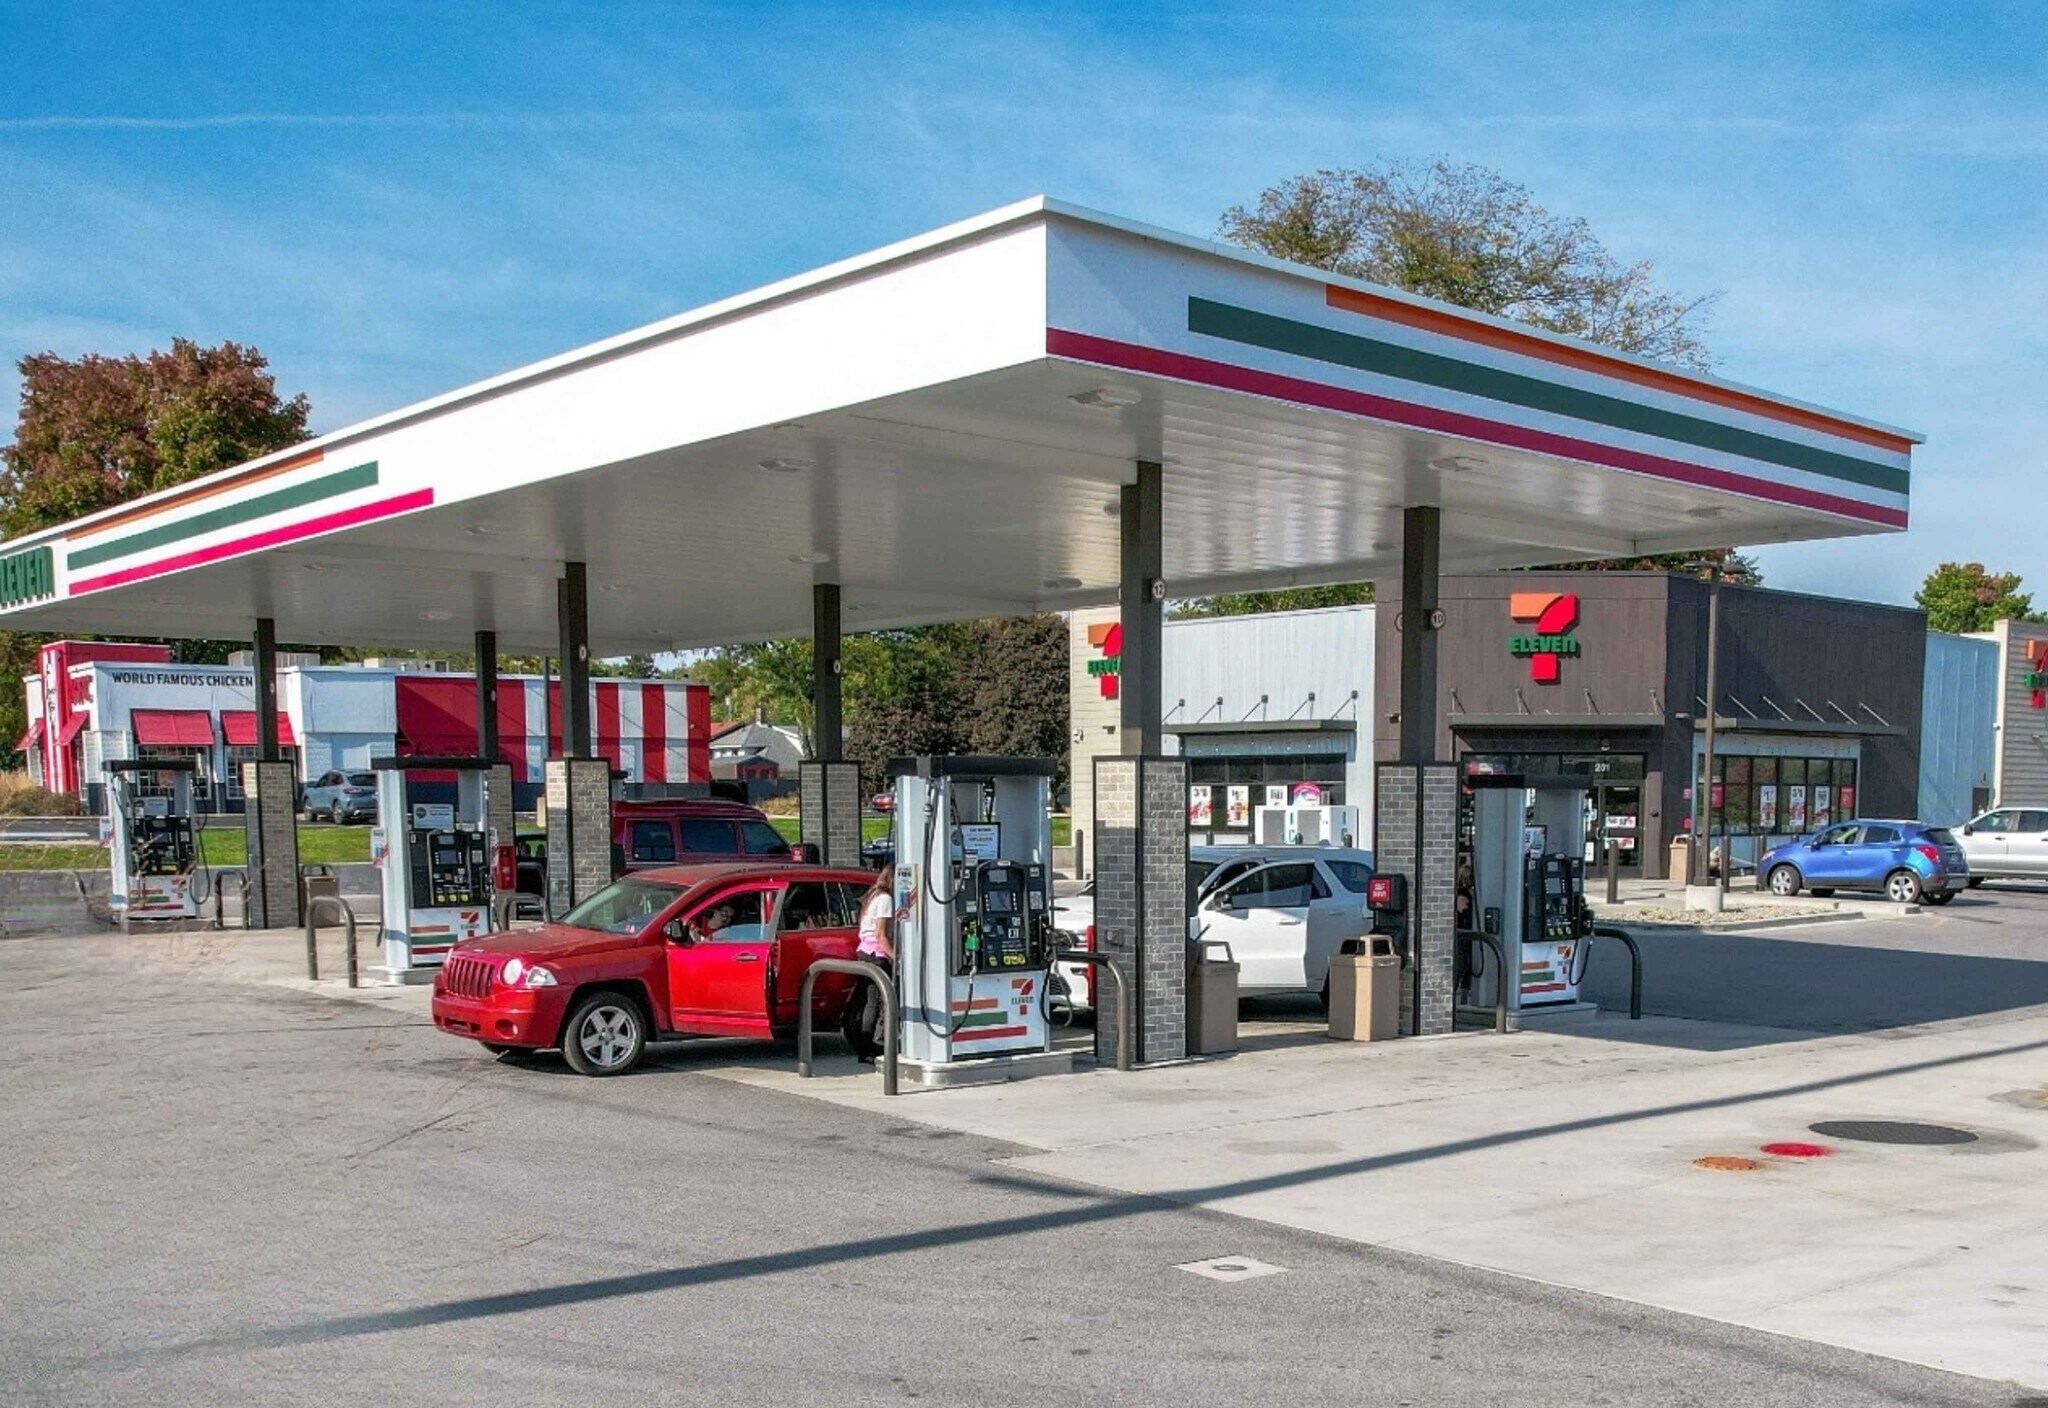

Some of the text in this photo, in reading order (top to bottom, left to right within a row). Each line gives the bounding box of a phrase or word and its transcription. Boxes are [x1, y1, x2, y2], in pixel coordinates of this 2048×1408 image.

[1087, 657, 1122, 675] ELEVE
[112, 672, 253, 687] WORLD FAMOUS CHICKEN
